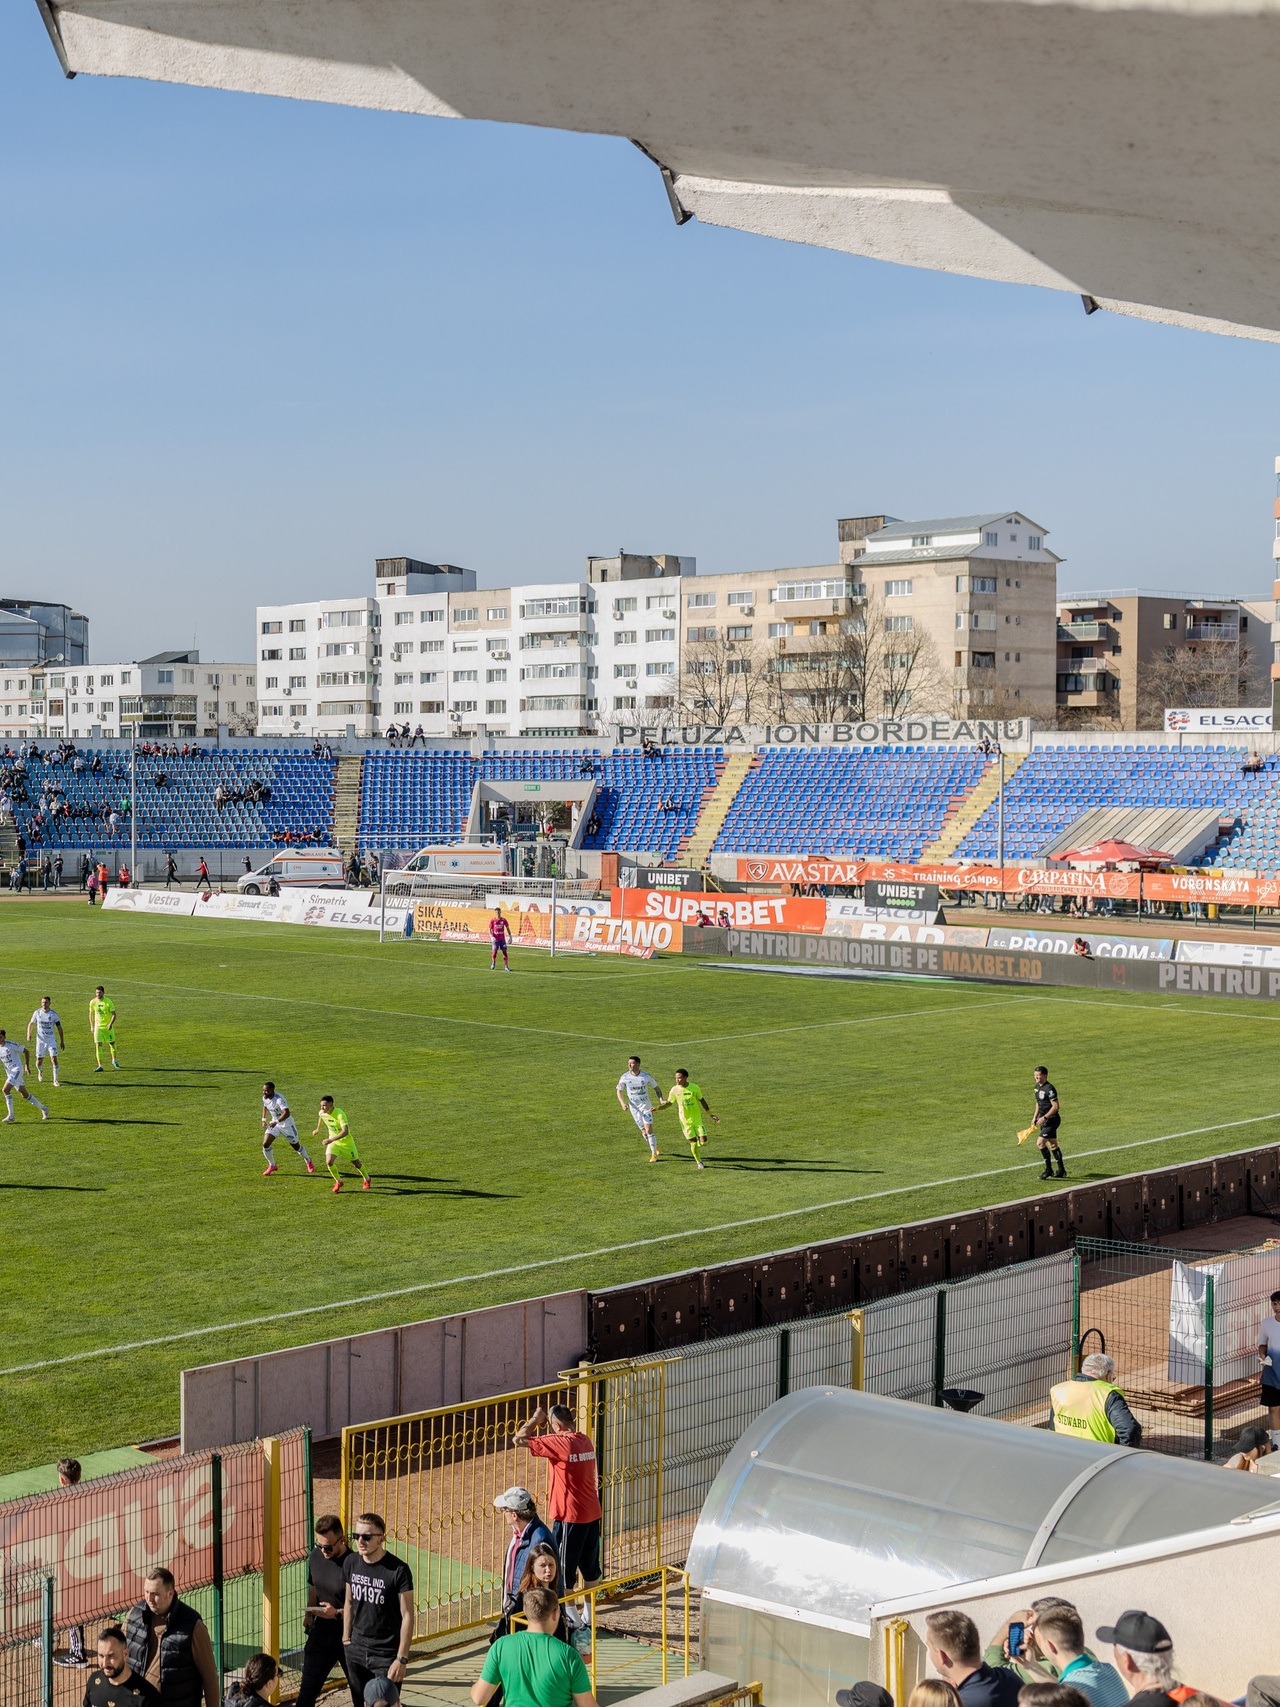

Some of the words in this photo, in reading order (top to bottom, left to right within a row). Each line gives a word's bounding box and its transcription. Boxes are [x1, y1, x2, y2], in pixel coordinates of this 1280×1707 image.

[619, 725, 746, 745] PELUZA
[765, 725, 821, 744] ION
[832, 720, 1023, 743] BORDEANU
[648, 873, 690, 886] UNIBET
[770, 863, 860, 883] AVASTAR
[1017, 869, 1107, 889] CARPATINA
[877, 884, 926, 899] UNIBET
[1172, 877, 1250, 893] VORONSKAYA
[148, 893, 181, 907] Vestra
[237, 900, 261, 909] Smart
[262, 902, 276, 910] Eco
[309, 895, 348, 906] Simetrix
[386, 898, 422, 908] UNIBET
[418, 906, 443, 919] SIKA
[645, 892, 787, 926] SUPERBET
[839, 905, 924, 920] ELSACO
[330, 913, 399, 926] ELSACO
[573, 917, 673, 950] BETANO
[1008, 936, 1150, 960] PRODCOM
[728, 930, 802, 959] PENTRU
[890, 946, 912, 969] DE
[916, 948, 939, 971] PE
[942, 950, 1043, 981] MAXBET.RO
[1158, 963, 1261, 996] PENTRU
[1057, 1413, 1088, 1430] STEWARD
[351, 1573, 372, 1586] DIESEL
[372, 1577, 386, 1589] IND.
